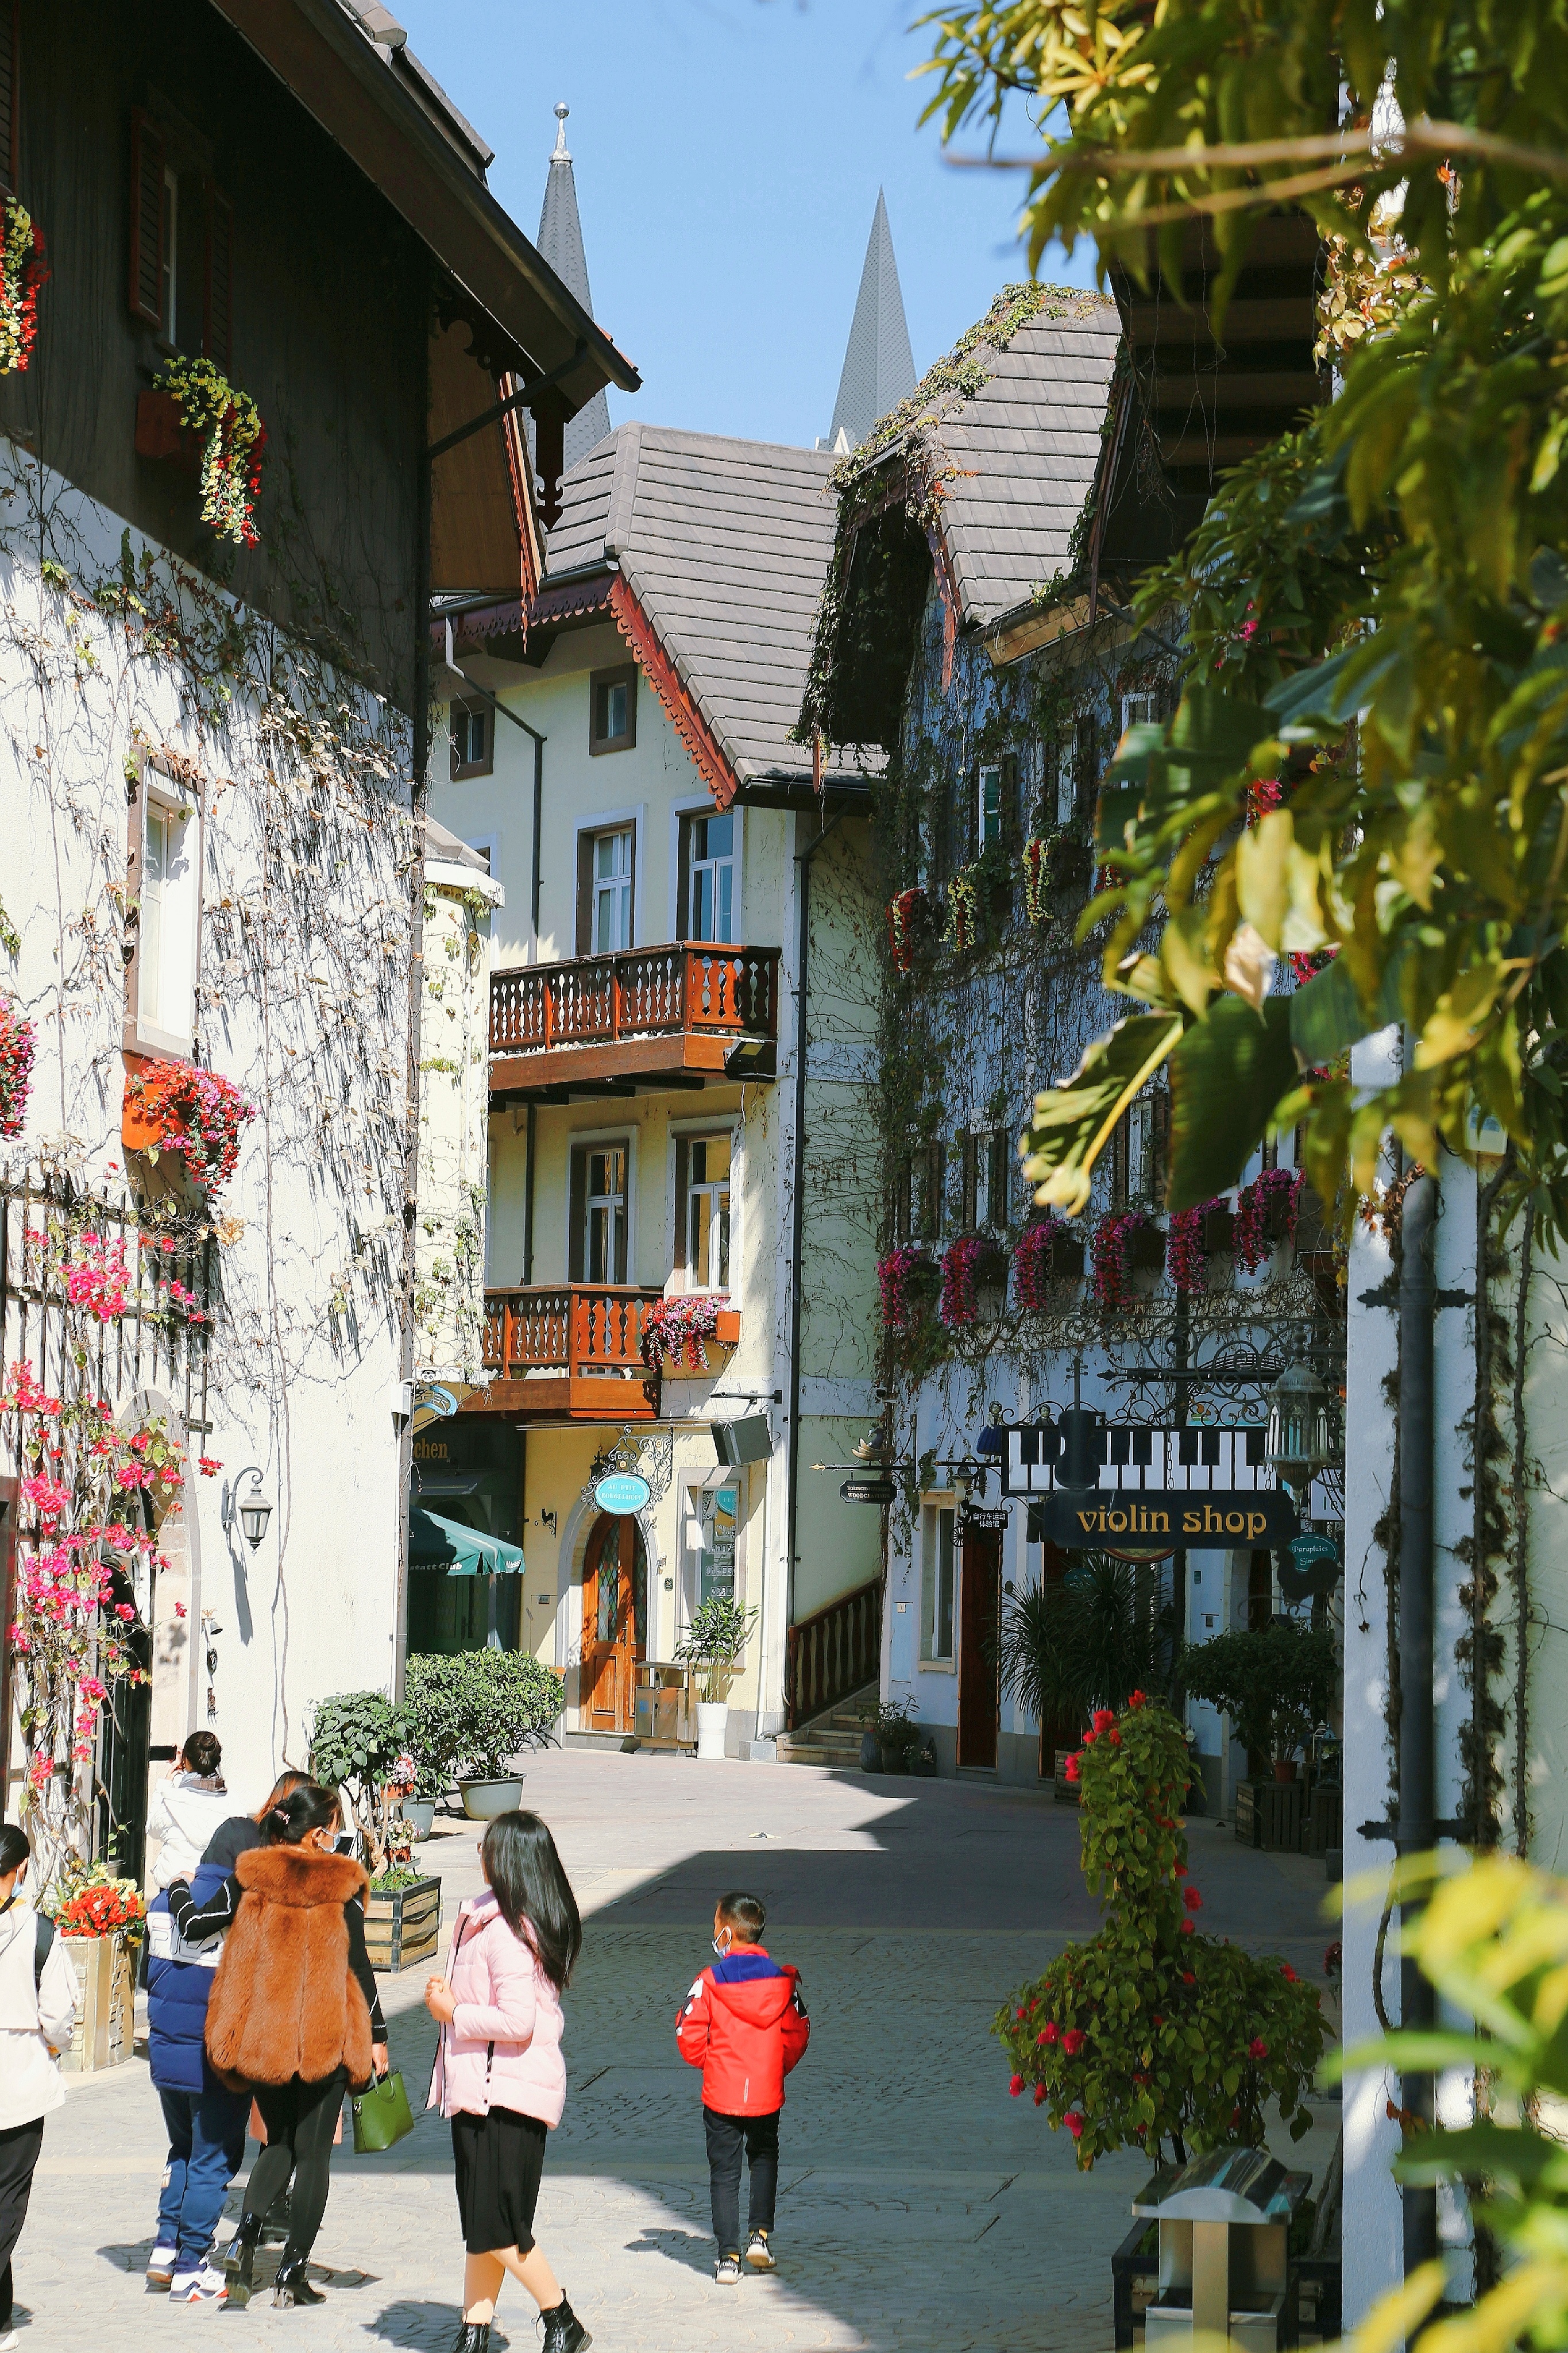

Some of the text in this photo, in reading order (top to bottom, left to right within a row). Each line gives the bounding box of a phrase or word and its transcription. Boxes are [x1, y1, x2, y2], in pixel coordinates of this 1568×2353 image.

[1076, 1504, 1266, 1540] violin shop
[1292, 1545, 1328, 1554] Parapluies
[438, 1561, 462, 1570] Club
